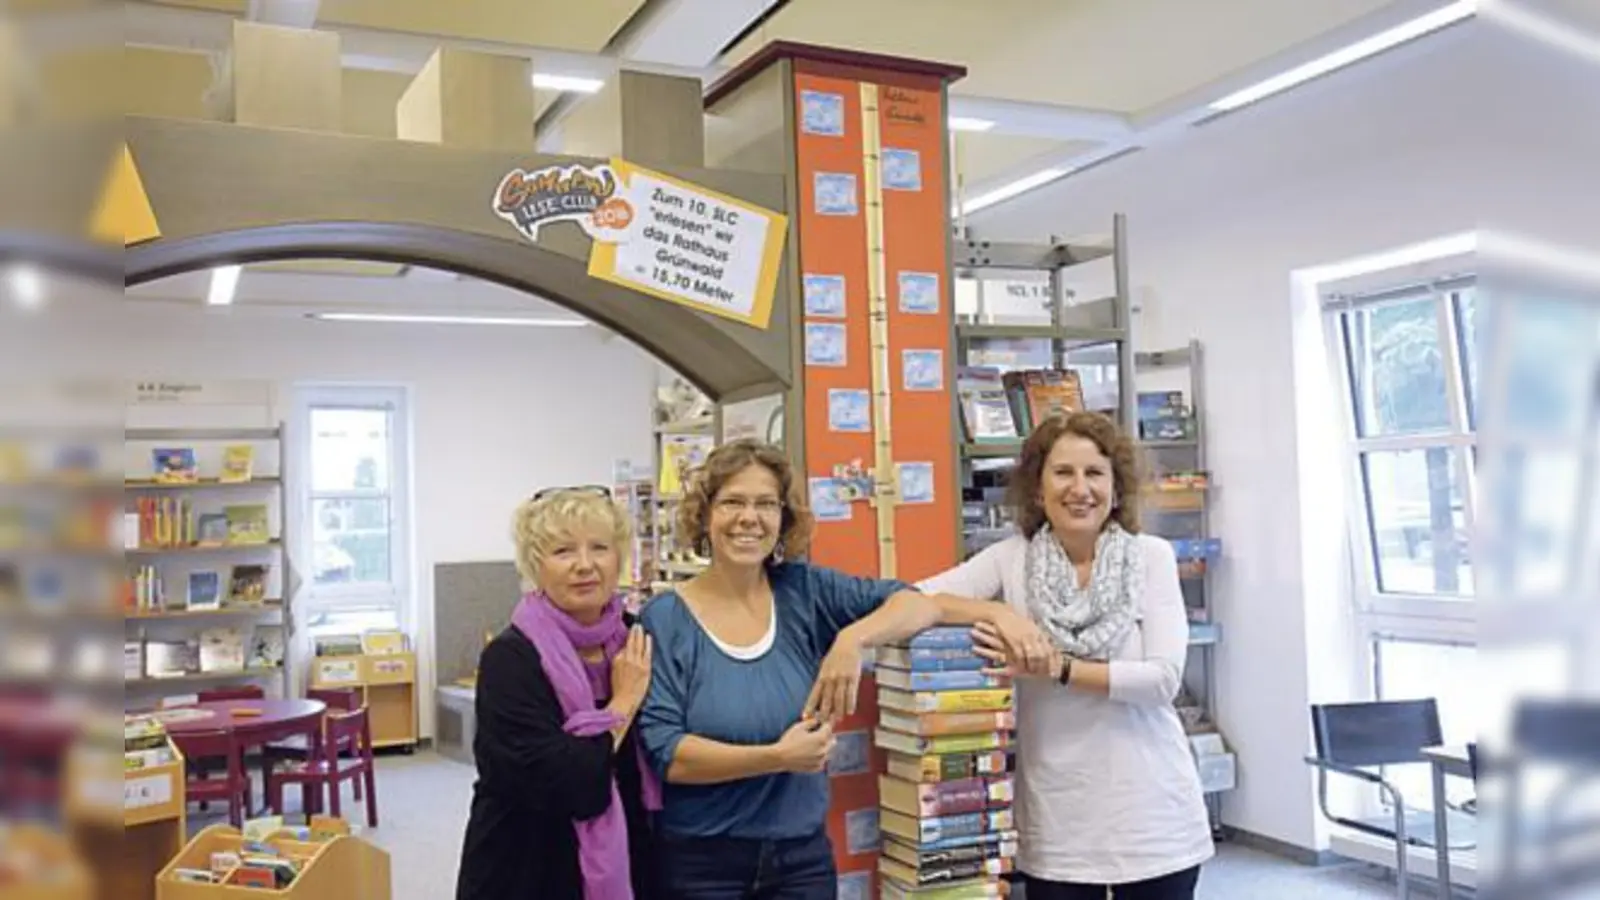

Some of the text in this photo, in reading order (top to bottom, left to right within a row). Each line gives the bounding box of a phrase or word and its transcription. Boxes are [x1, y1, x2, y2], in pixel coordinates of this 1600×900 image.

[652, 187, 683, 208] Zum
[712, 206, 739, 225] SLC
[650, 206, 733, 244] "erlesen" wir
[643, 226, 729, 262] das Rathaus
[655, 247, 723, 280] Grünwald
[653, 267, 690, 290] 15,70
[694, 279, 734, 302] Meter
